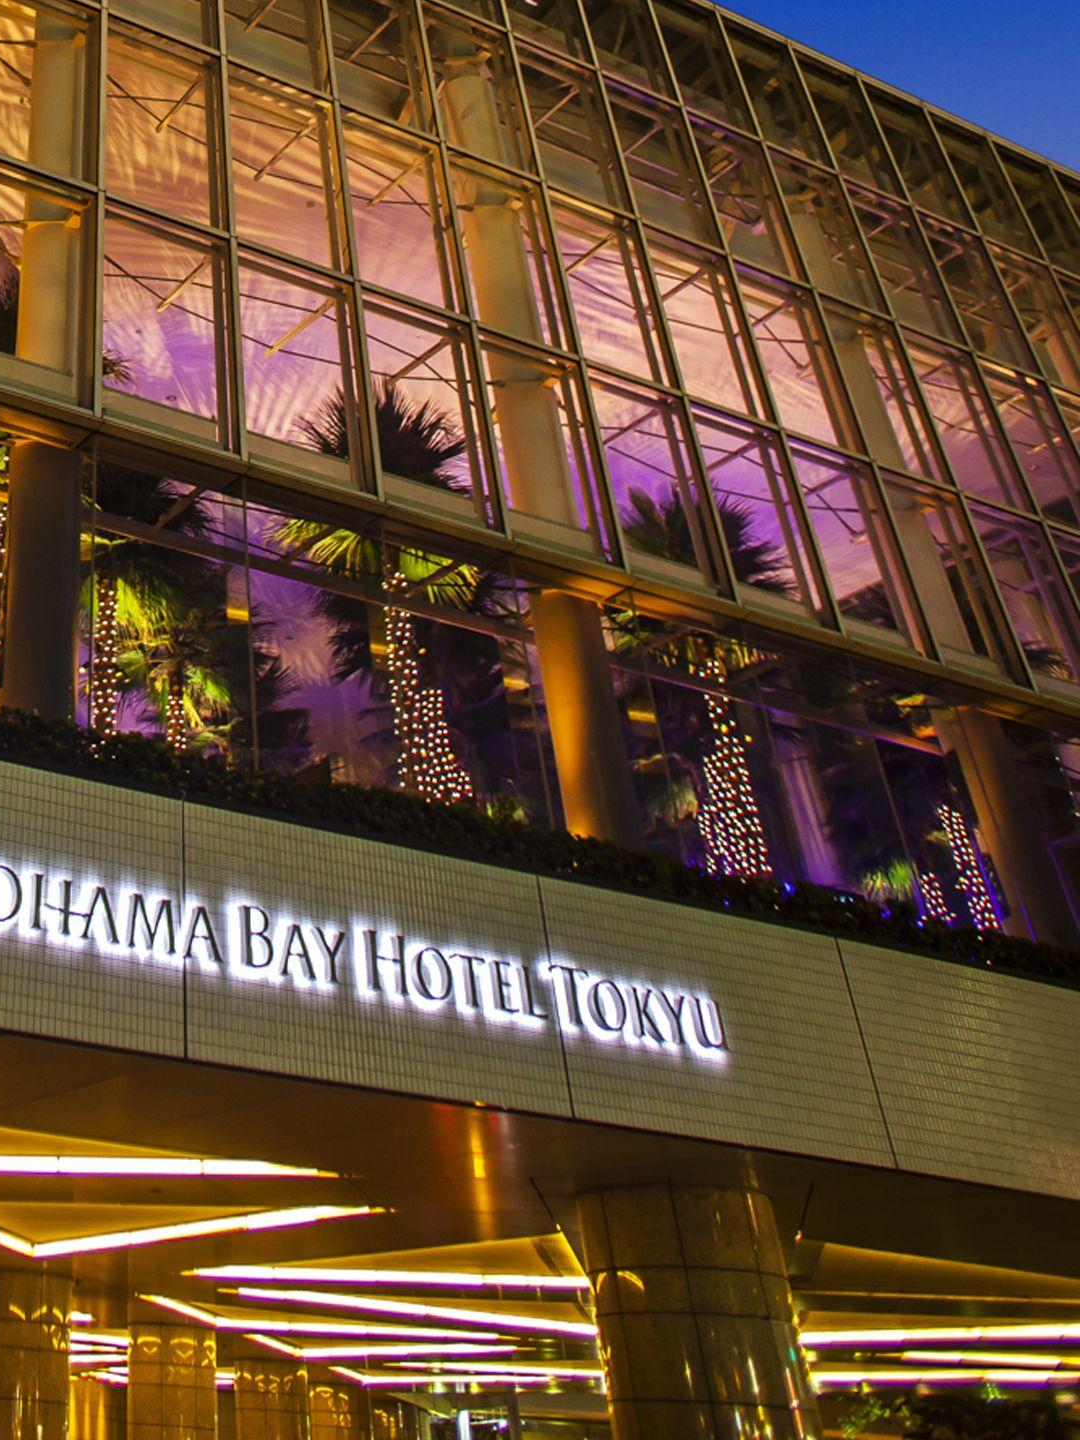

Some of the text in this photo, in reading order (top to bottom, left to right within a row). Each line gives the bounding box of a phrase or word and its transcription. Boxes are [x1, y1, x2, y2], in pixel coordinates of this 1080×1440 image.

[237, 904, 346, 984] BAY
[363, 928, 549, 1020] HOTEL
[549, 964, 729, 1051] TOKYU
